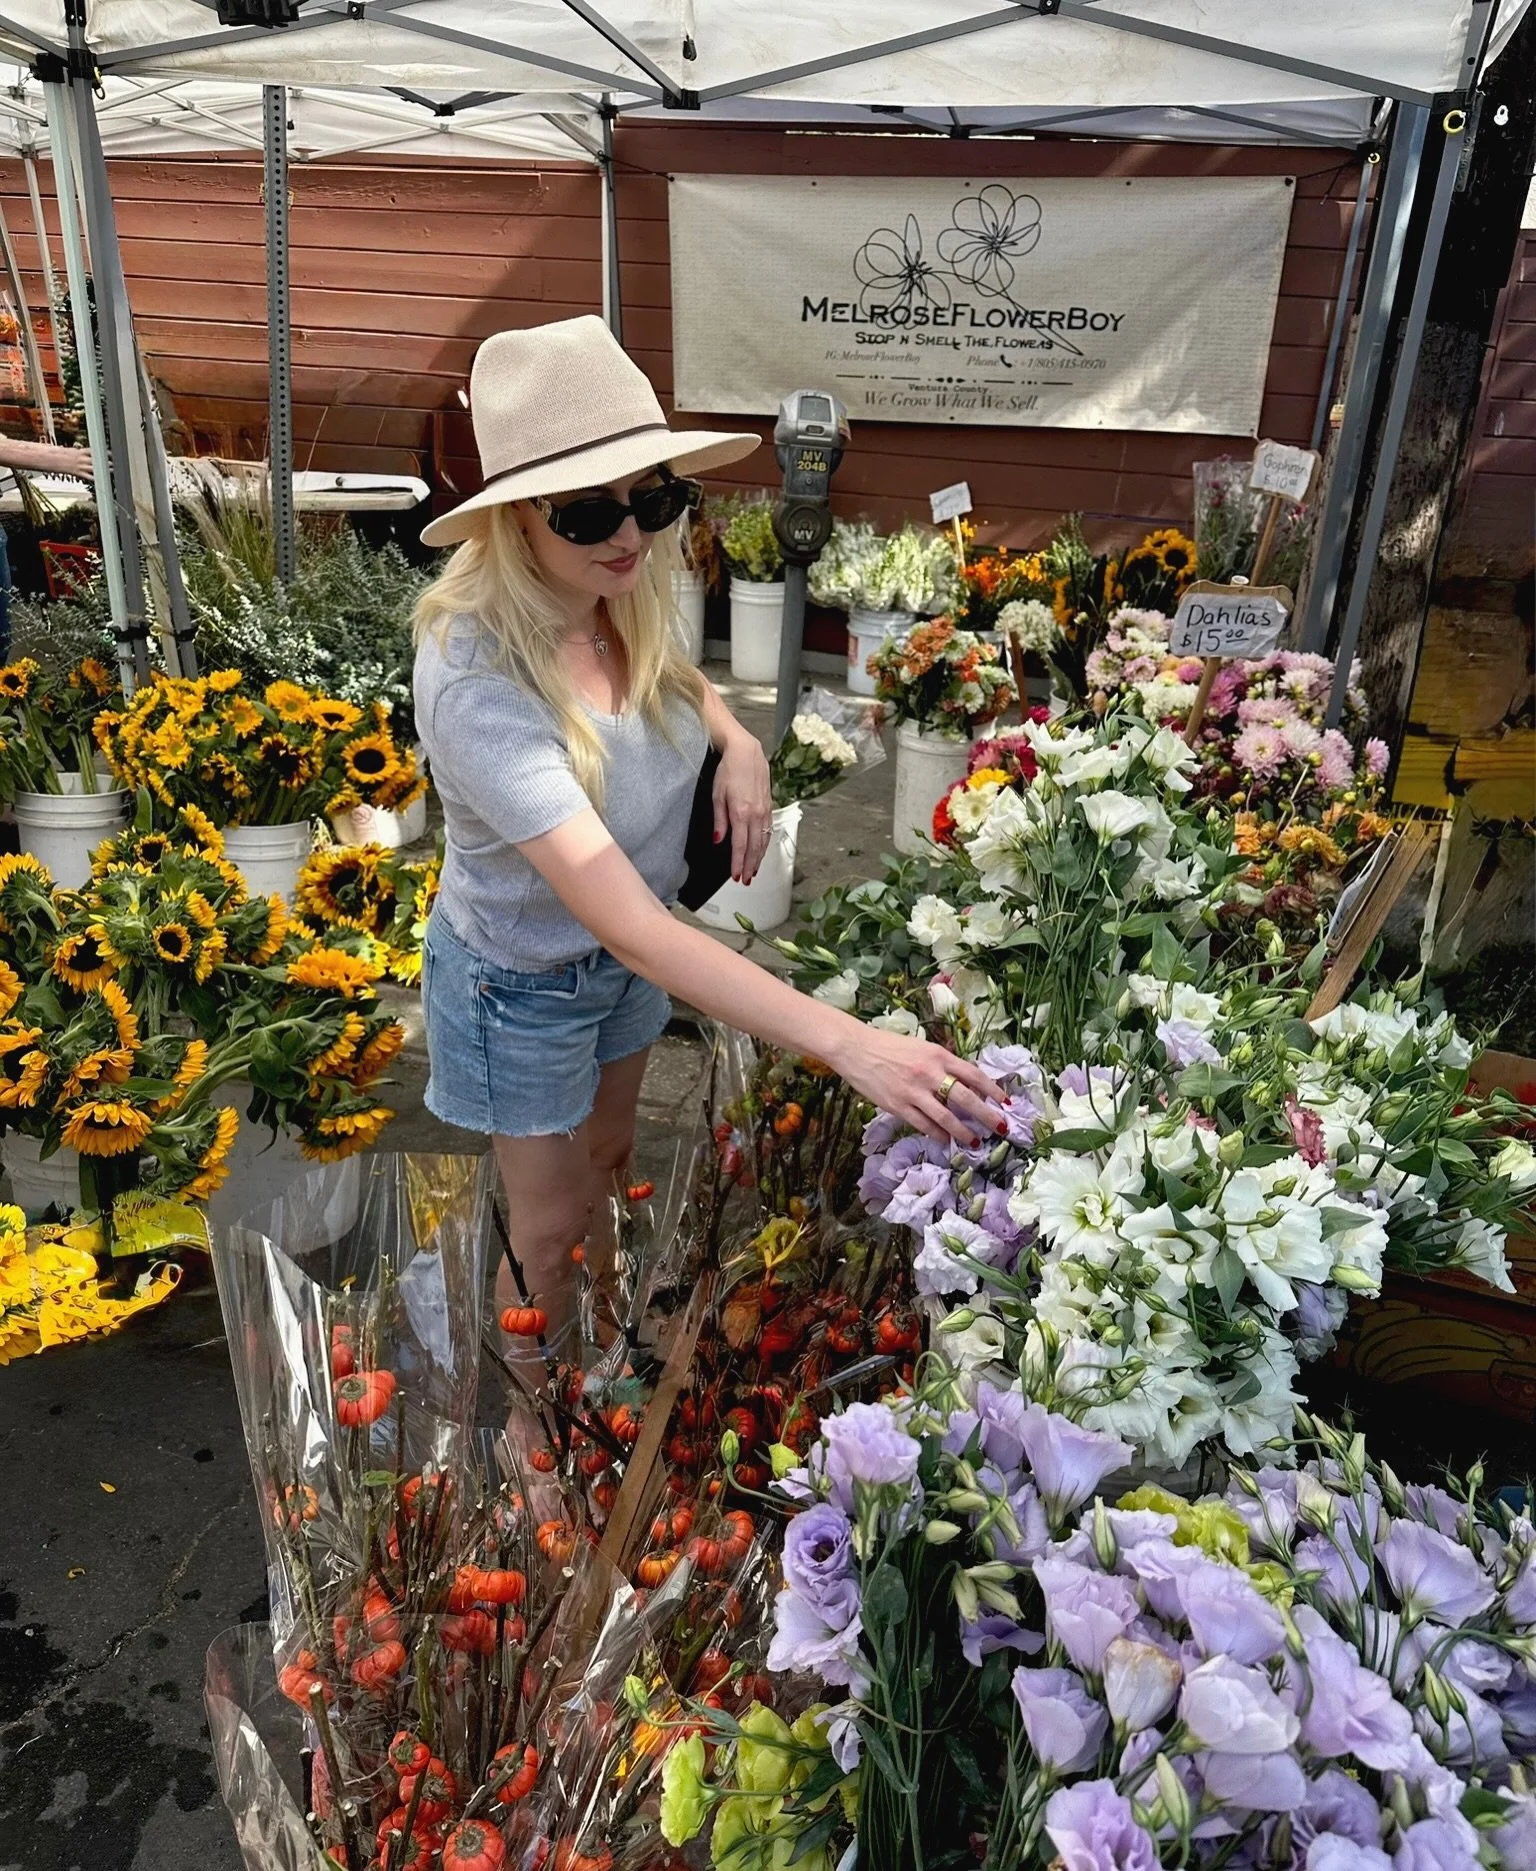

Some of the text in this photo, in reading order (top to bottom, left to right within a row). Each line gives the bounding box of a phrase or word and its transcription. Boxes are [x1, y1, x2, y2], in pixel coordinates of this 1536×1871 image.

[966, 355, 998, 367] Phone
[908, 383, 948, 392] Ventura
[865, 391, 888, 406] We
[891, 392, 932, 407] Grow
[935, 393, 976, 409] What
[980, 394, 1005, 409] We
[803, 451, 822, 462] MV
[794, 530, 814, 540] MV
[1186, 604, 1271, 628] Dahlias
